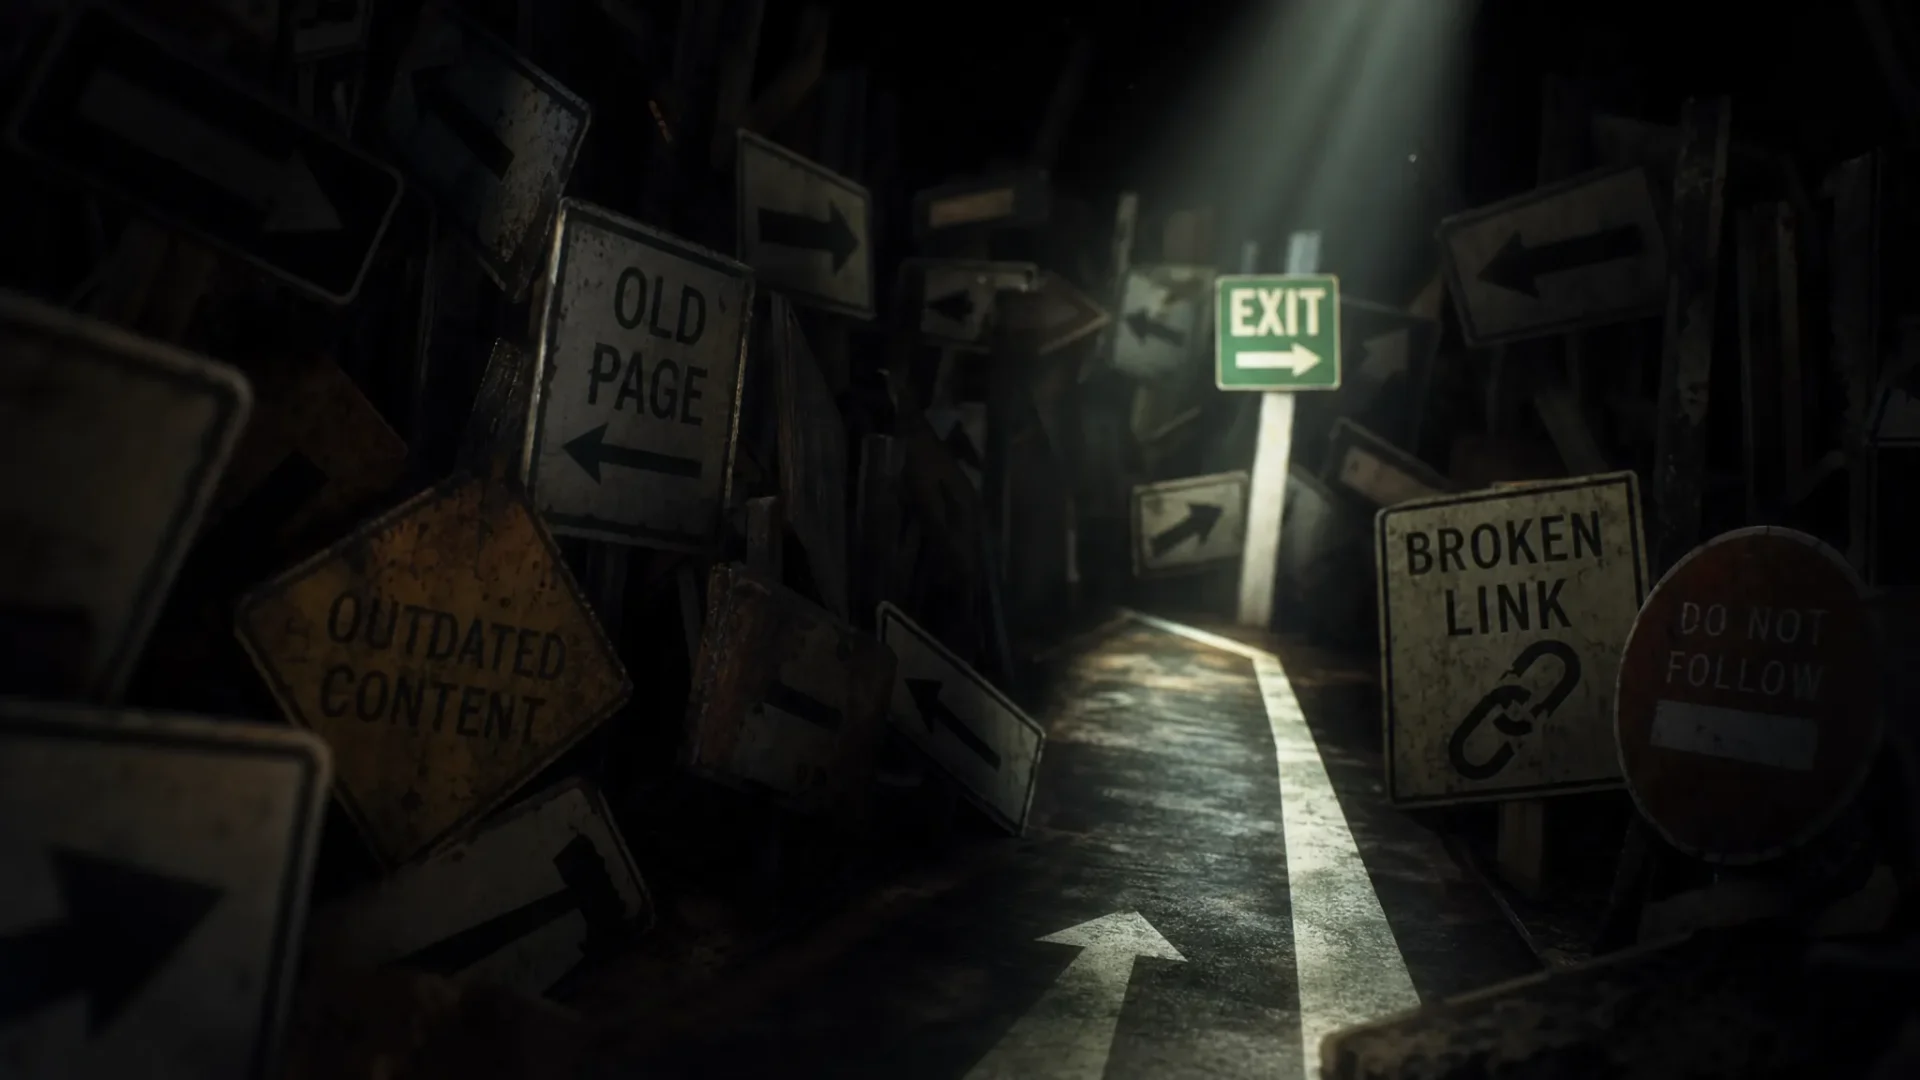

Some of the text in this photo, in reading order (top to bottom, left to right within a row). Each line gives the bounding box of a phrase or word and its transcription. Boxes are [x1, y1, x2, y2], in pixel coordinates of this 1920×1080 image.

[615, 267, 706, 345] OLD
[1230, 287, 1326, 337] EXIT
[588, 342, 708, 426] PAGE
[1407, 511, 1603, 576] BROKEN
[328, 591, 567, 681] OUTDATED
[1446, 579, 1572, 636] LINK
[1681, 602, 1831, 646] DO NOT
[320, 665, 546, 744] CONTENT
[1666, 651, 1826, 701] FOLLOW
